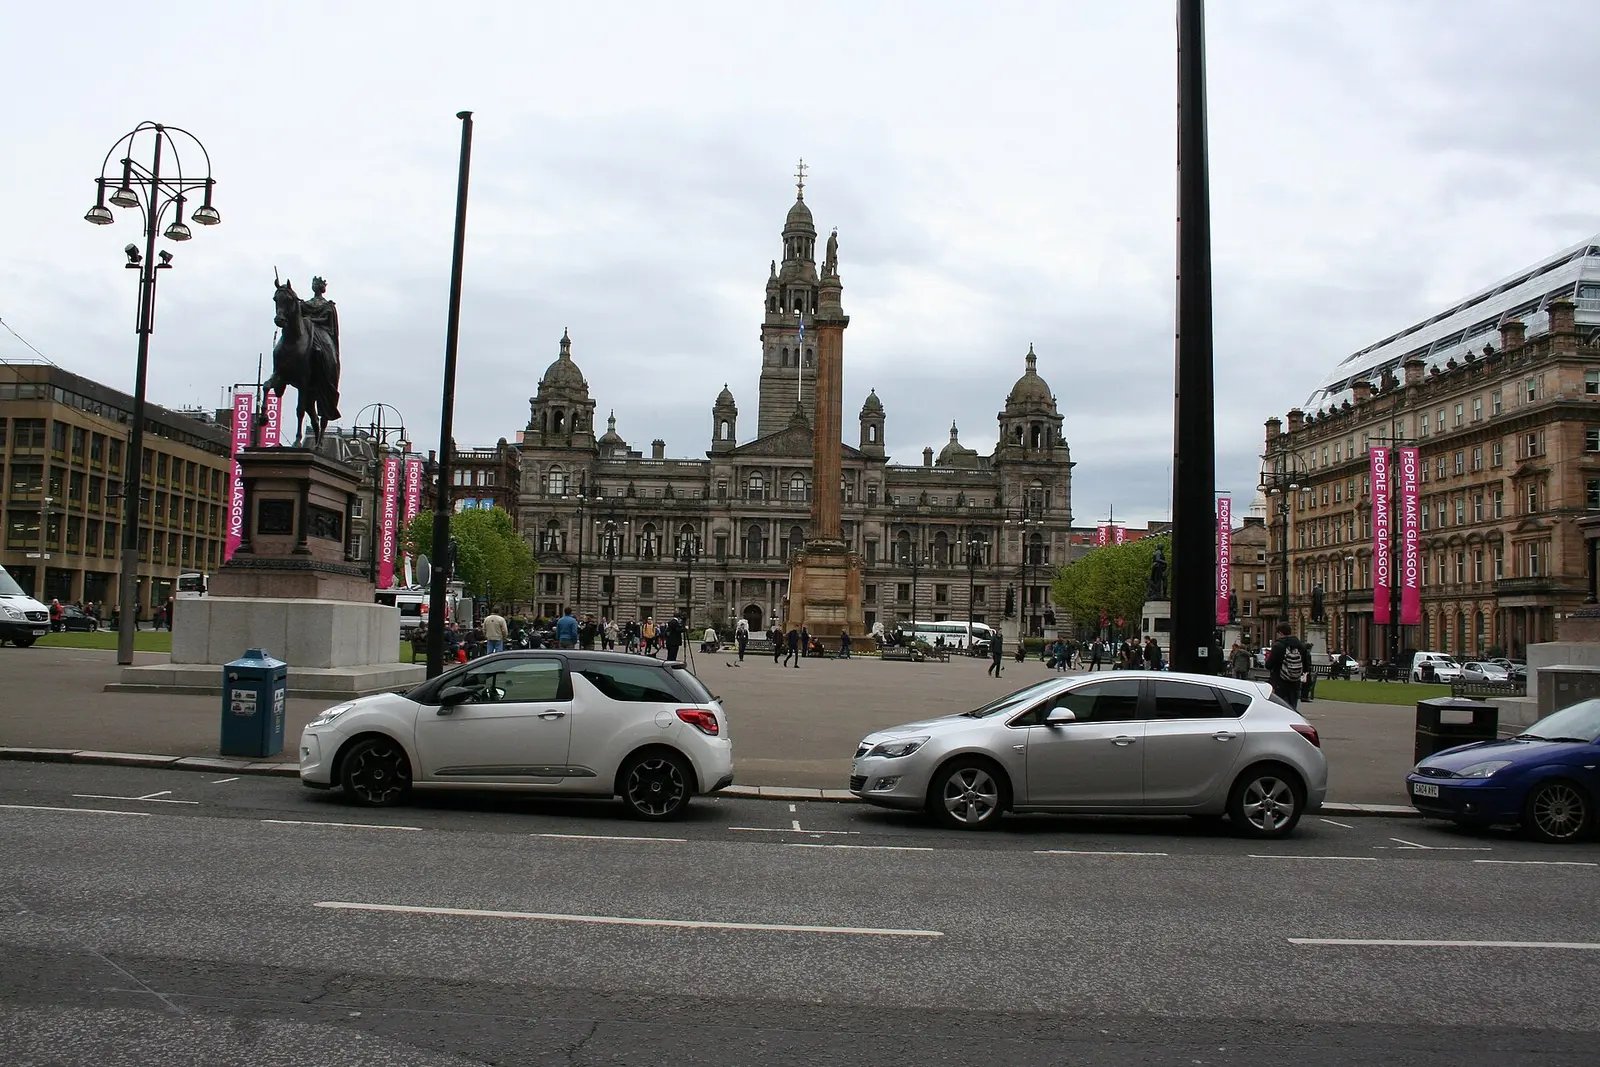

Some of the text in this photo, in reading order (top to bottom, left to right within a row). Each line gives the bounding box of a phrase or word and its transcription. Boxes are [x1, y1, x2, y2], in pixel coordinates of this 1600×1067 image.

[237, 397, 249, 439] PEOPLE
[265, 396, 278, 439] PEOPLE
[407, 494, 417, 519] MAKE
[409, 461, 419, 493] PEOPLE
[231, 478, 244, 537] GLASGOW
[383, 461, 396, 563] PEOPLE MAKE GLASGOW
[1374, 450, 1388, 588] PEOPLE MAKE GLASGOW
[1403, 451, 1417, 589] PEOPLE MAKE GLASGOW
[1220, 500, 1229, 600] PEOPLE MAKE GLASGOW
